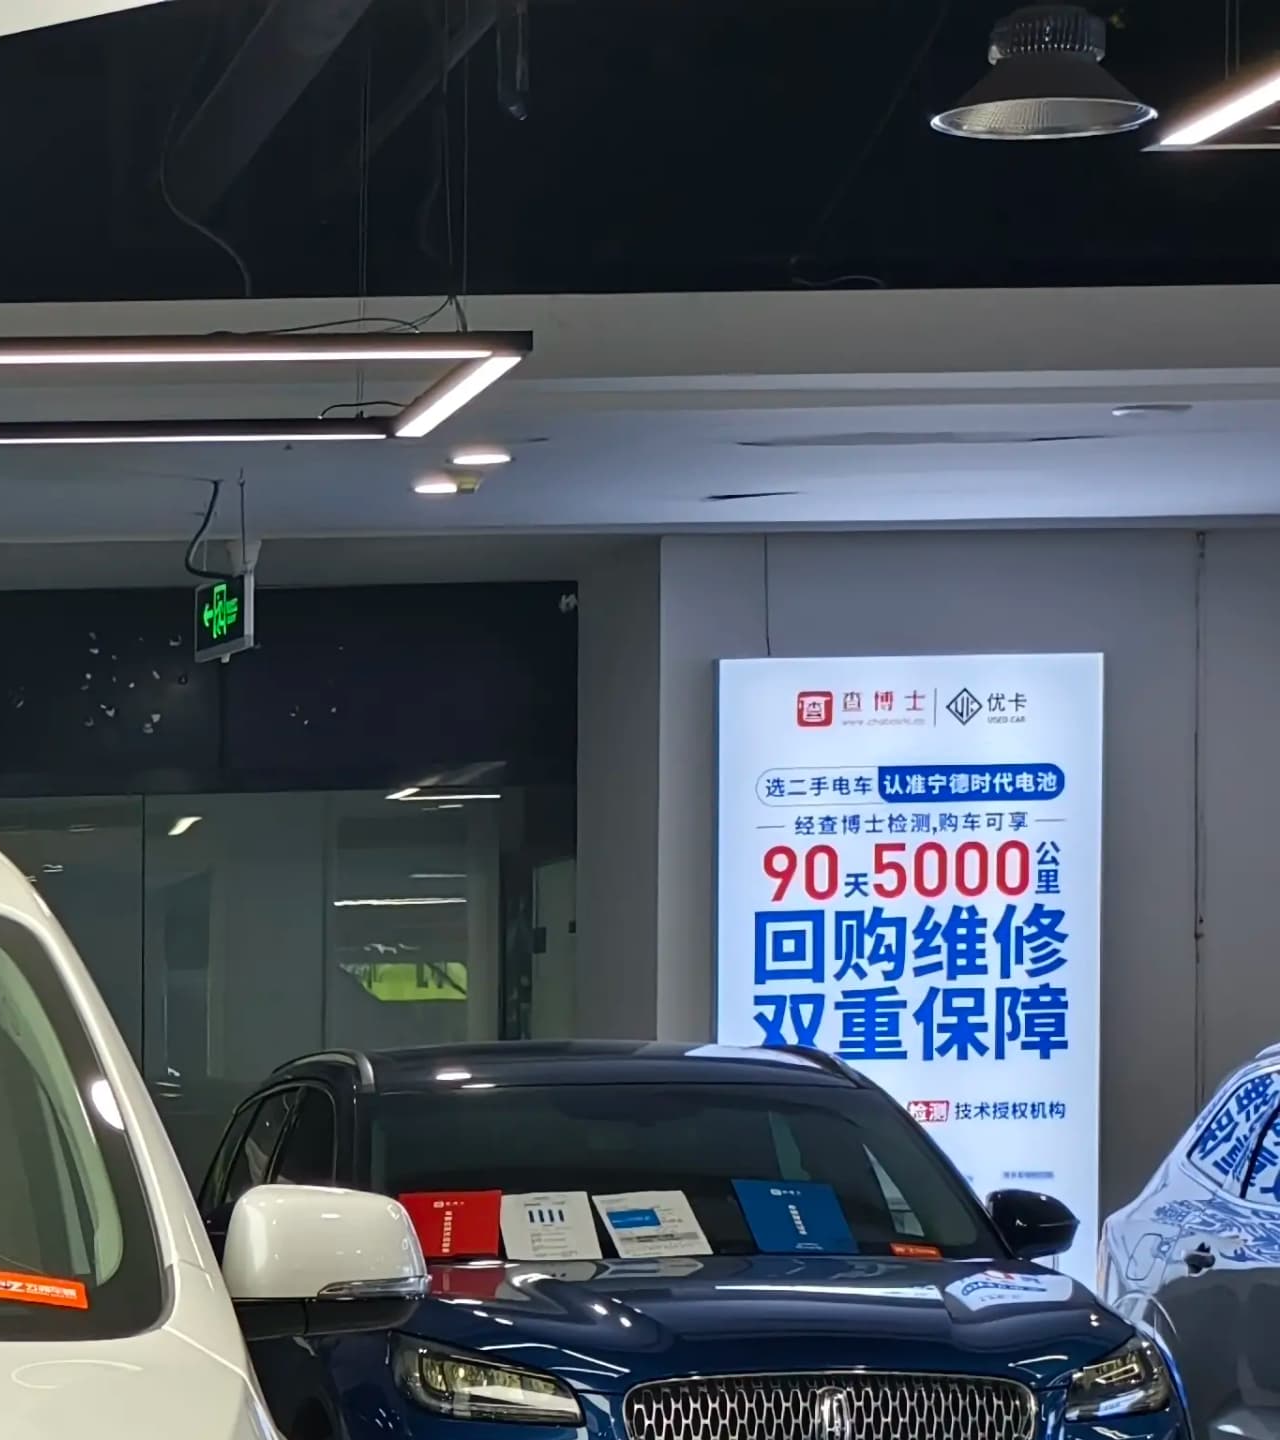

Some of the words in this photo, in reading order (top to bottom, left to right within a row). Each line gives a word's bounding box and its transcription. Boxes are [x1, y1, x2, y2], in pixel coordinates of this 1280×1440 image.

[987, 692, 1027, 712] 优卡
[765, 775, 873, 797] 选二手电车
[883, 772, 1058, 795] 认准宁德时代电池
[754, 903, 1069, 985] 回购维修
[753, 983, 1069, 1062] 双重保障
[954, 1101, 1066, 1120] 技术授权机构
